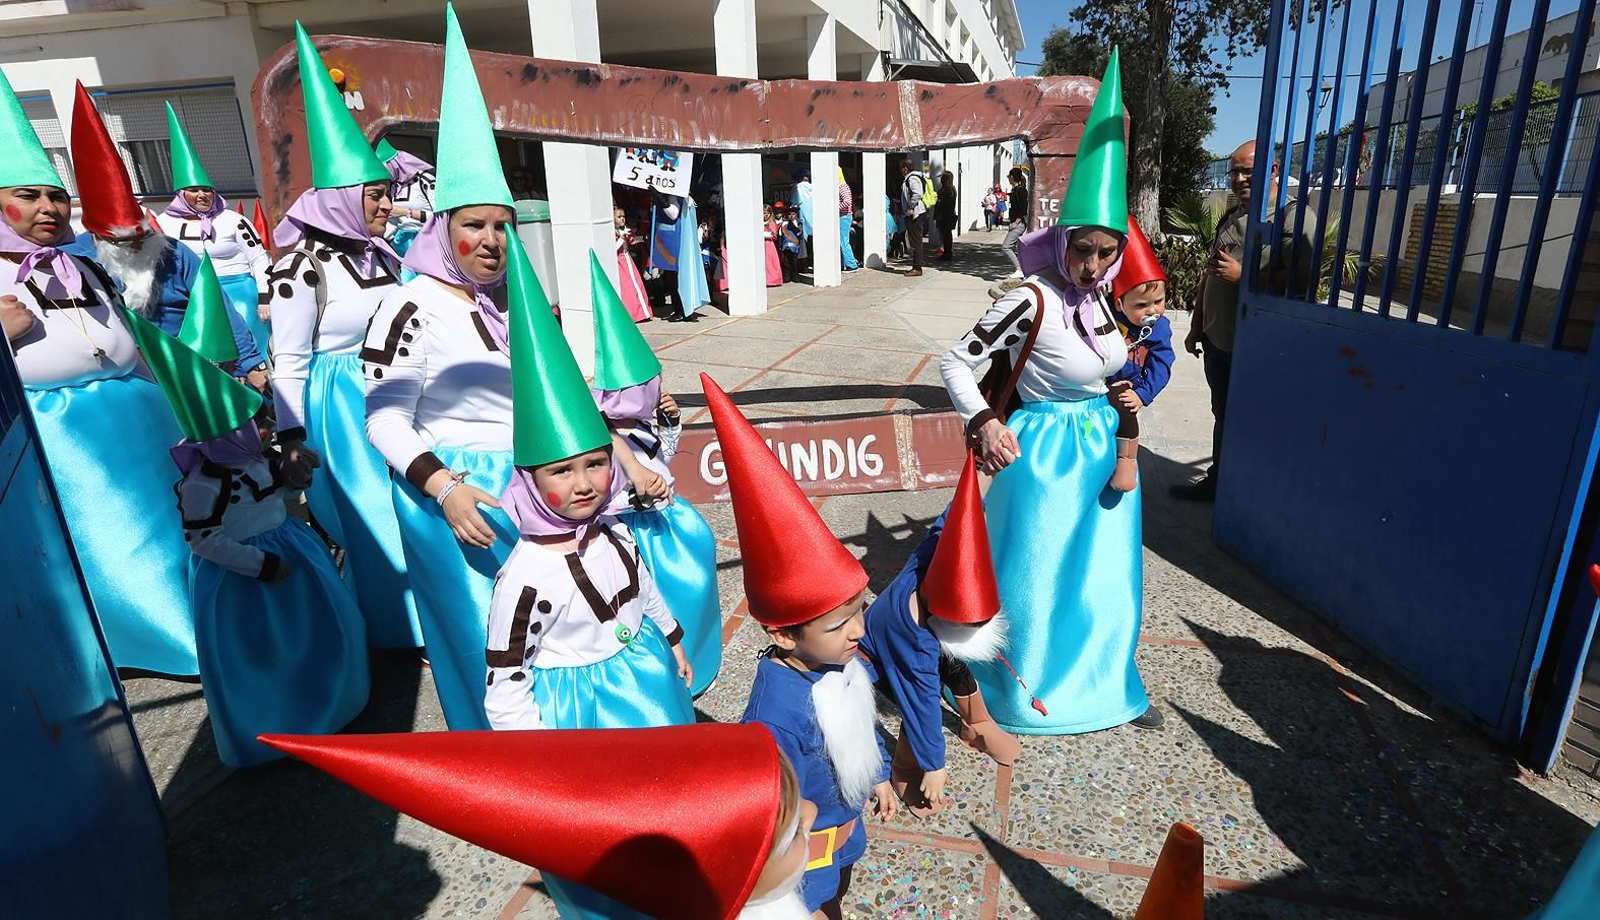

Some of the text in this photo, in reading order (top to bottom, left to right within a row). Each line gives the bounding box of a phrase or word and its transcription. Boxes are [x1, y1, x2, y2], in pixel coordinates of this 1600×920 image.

[627, 166, 677, 188] 5 años
[700, 434, 884, 486] GUNDIG
